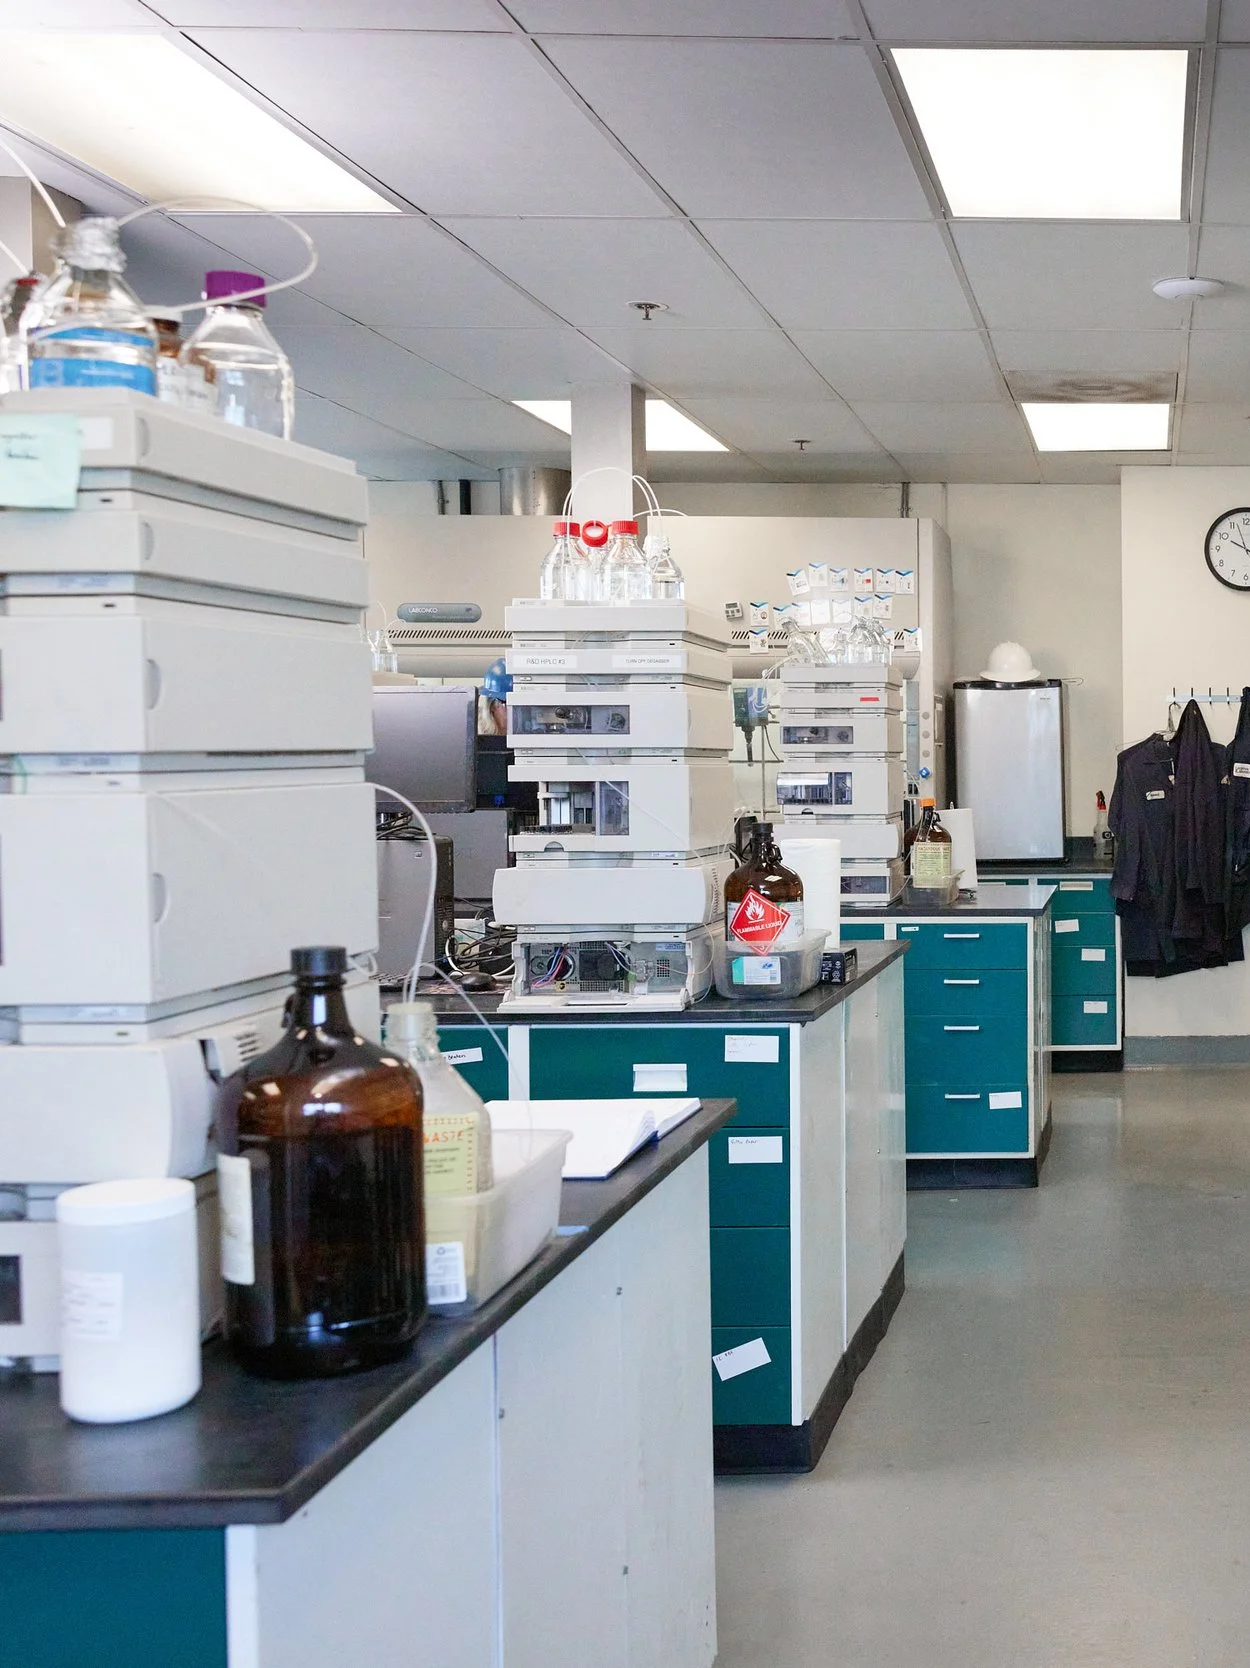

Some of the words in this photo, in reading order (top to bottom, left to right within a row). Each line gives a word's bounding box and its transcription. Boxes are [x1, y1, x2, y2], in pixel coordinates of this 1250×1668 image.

[1242, 517, 1250, 526] 12
[1219, 532, 1230, 540] 10
[1231, 569, 1236, 577] 7
[1243, 573, 1249, 581] 6
[736, 924, 764, 934] FLAMMABLE
[765, 920, 782, 929] LIQUID
